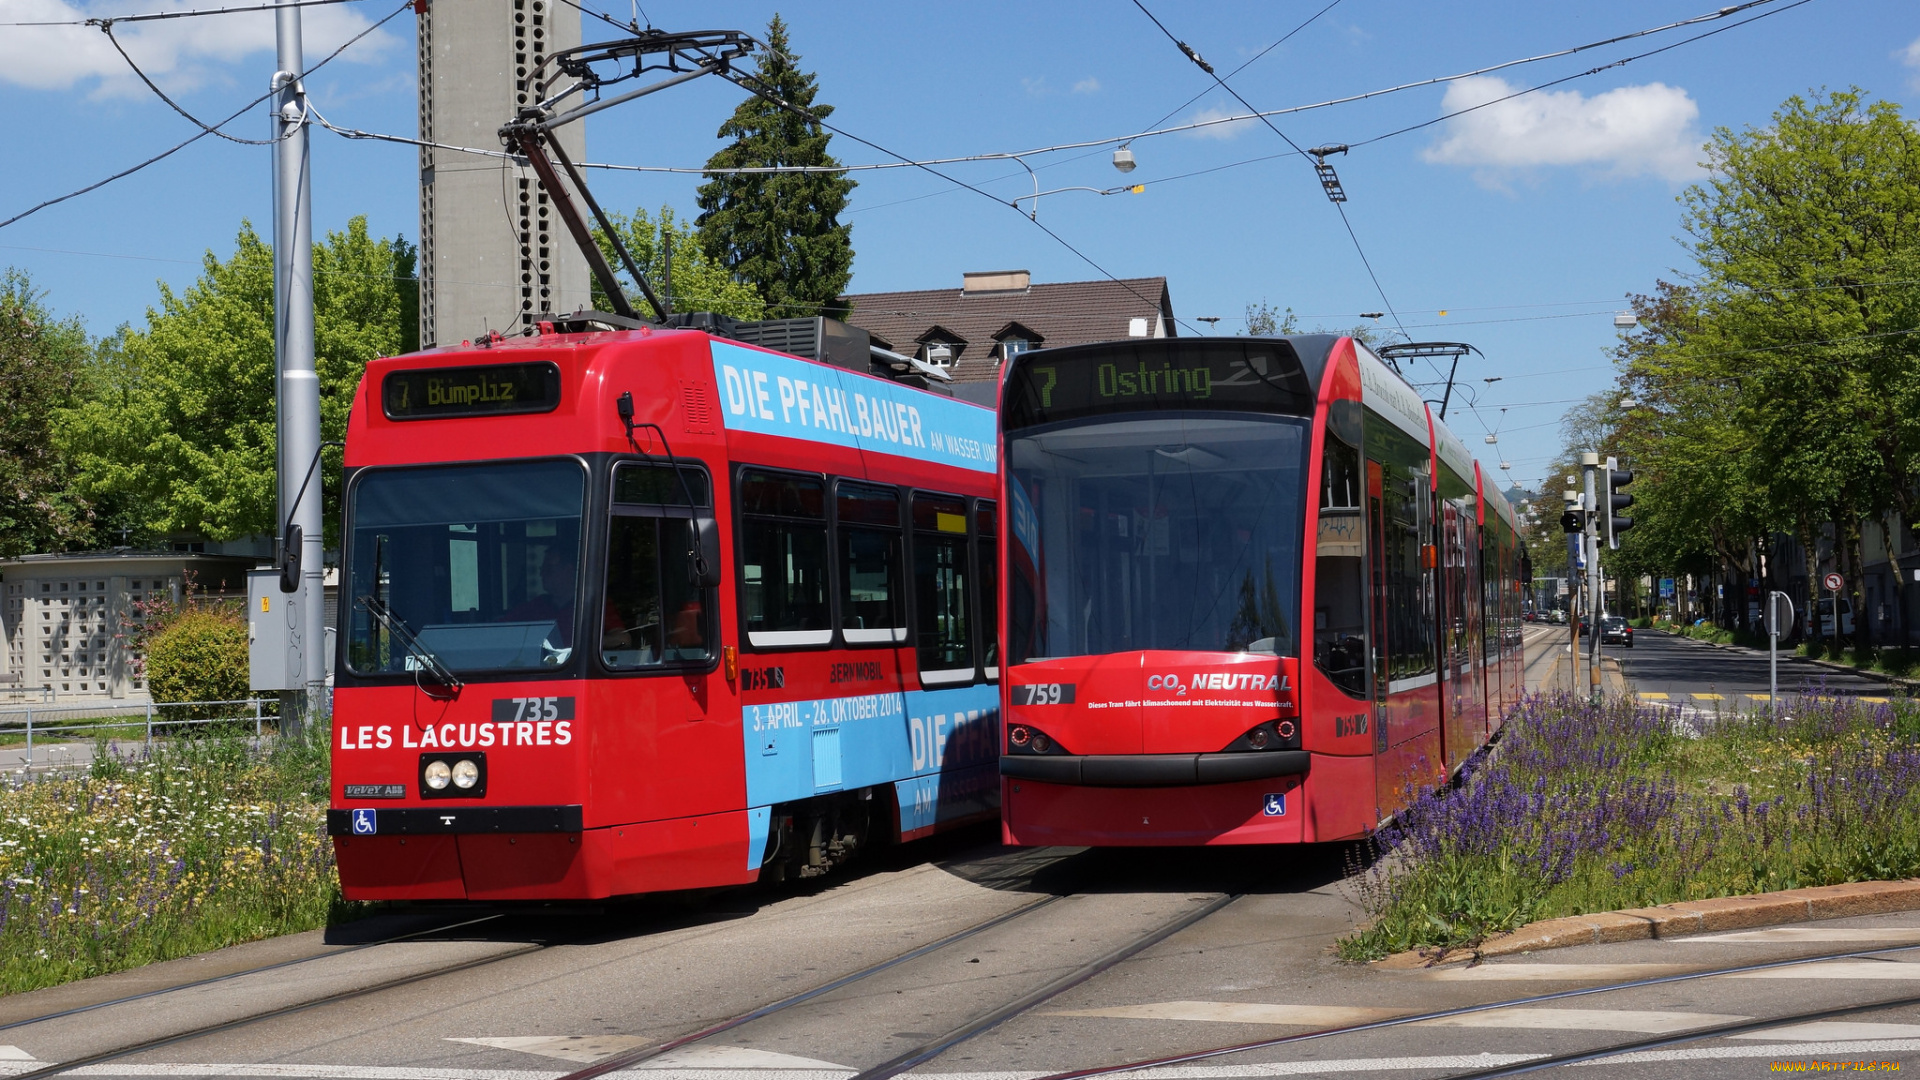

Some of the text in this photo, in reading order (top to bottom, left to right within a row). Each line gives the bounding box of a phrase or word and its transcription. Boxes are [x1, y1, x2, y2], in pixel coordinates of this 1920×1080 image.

[397, 374, 513, 408] 7 Bümpliz
[1033, 362, 1211, 408] 7 Ostring
[723, 364, 926, 448] DIE PFAHLBAUER
[930, 431, 944, 453] AM
[945, 434, 982, 460] WASSER
[1025, 683, 1061, 706] 759
[1191, 673, 1292, 691] NEUTRAL
[512, 697, 559, 722] 735
[753, 706, 764, 732] 3.
[767, 702, 804, 730] APRIL
[813, 700, 831, 725] 26.
[832, 695, 878, 722] OKTOBER
[879, 692, 902, 716] 2014
[1088, 701, 1107, 709] Dieses
[1125, 699, 1141, 708] fährt
[1142, 699, 1190, 707] klimaschonend
[1192, 699, 1203, 707] mit
[1205, 699, 1241, 707] Elektrizität
[1254, 700, 1293, 708] Wasserkraft.
[340, 721, 572, 750] LES LACUSTRES
[910, 714, 947, 772] DIE
[914, 786, 931, 816] AM
